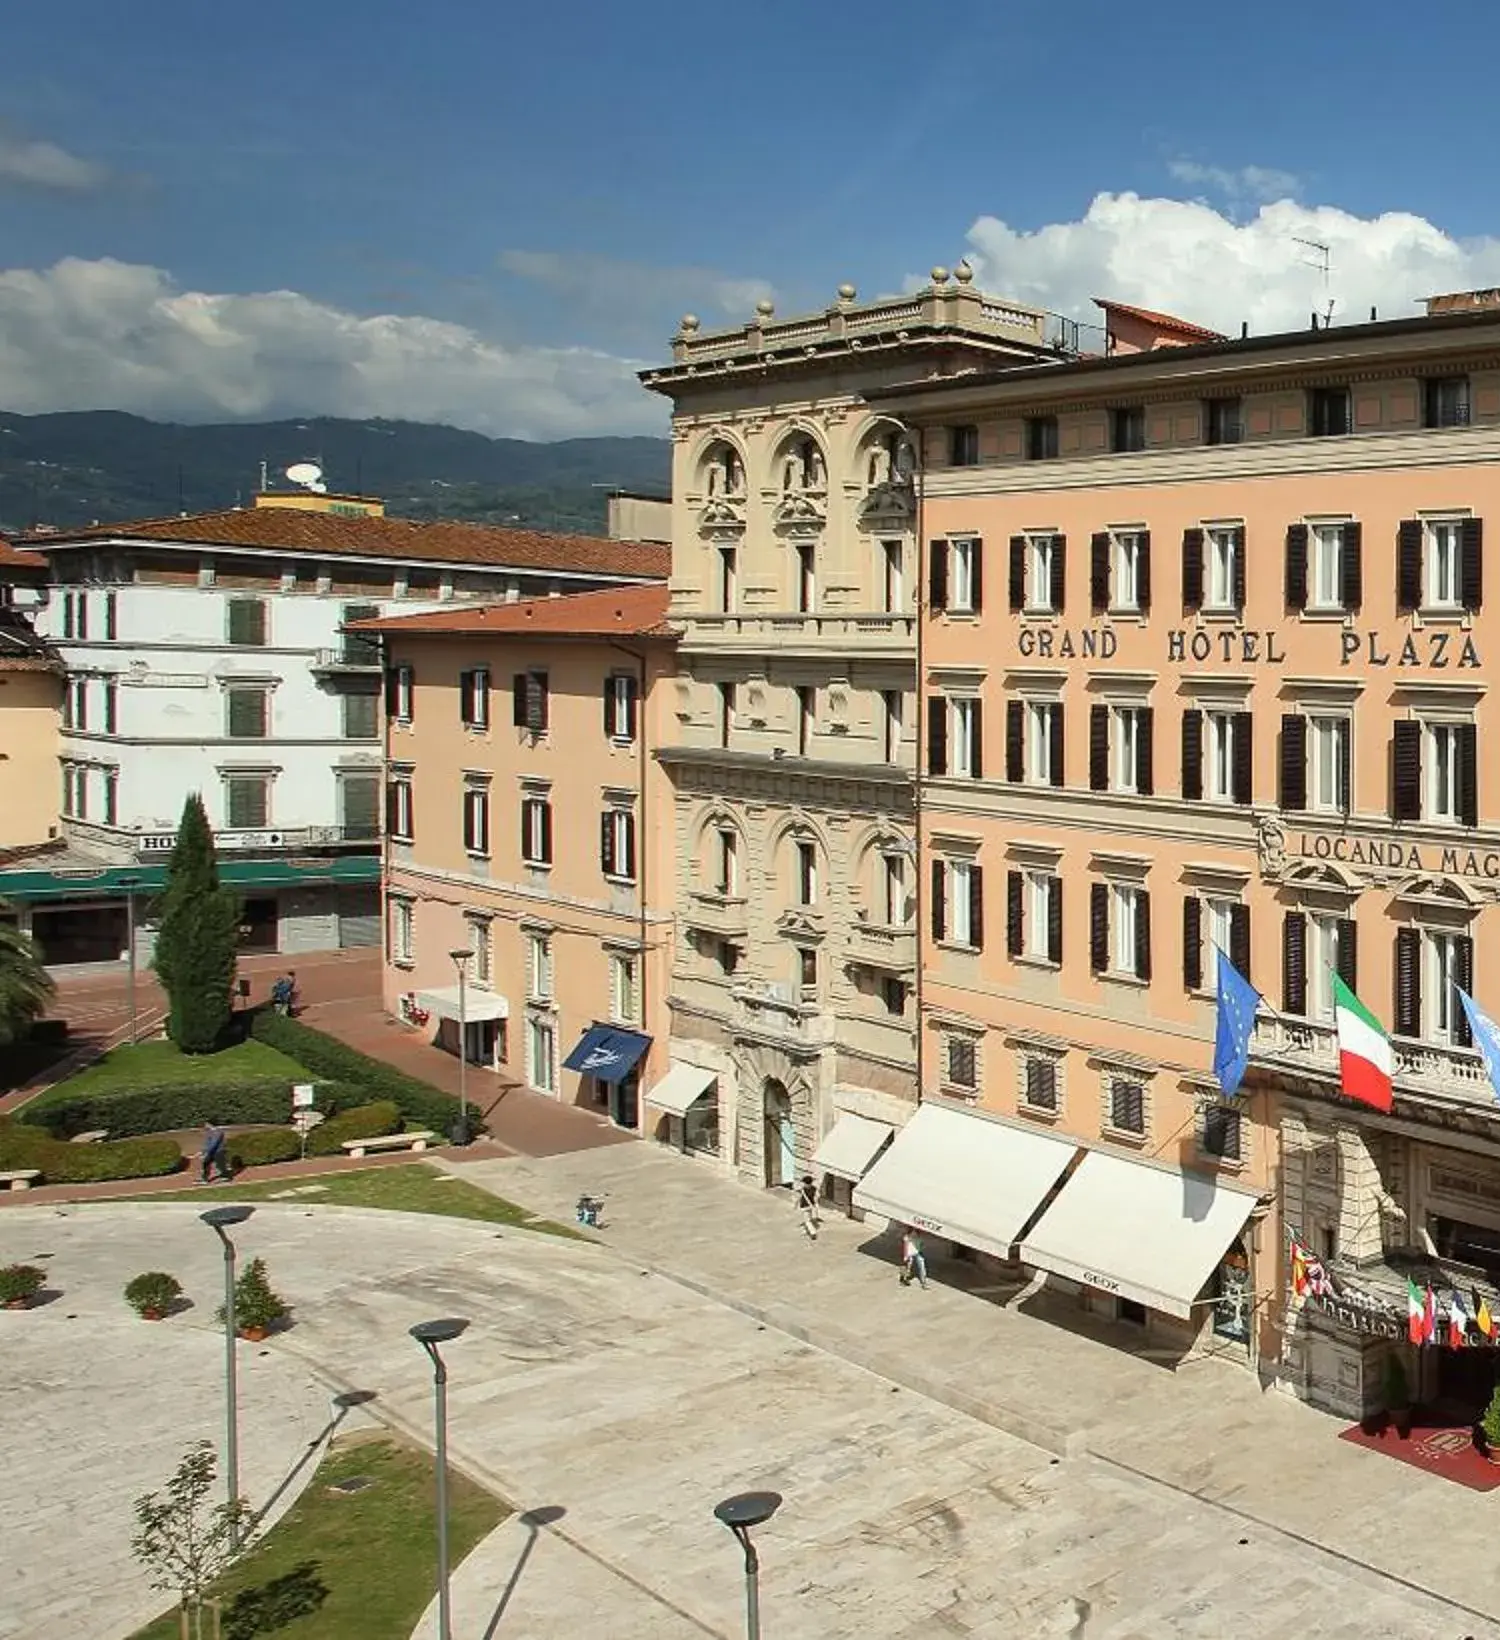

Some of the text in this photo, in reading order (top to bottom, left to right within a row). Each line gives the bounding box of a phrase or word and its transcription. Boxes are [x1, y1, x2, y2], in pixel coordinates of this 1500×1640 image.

[1018, 629, 1482, 668] GRAND HOTEL PLAZA
[1301, 834, 1423, 870] LOCANDA
[1083, 1271, 1119, 1291] GEOX
